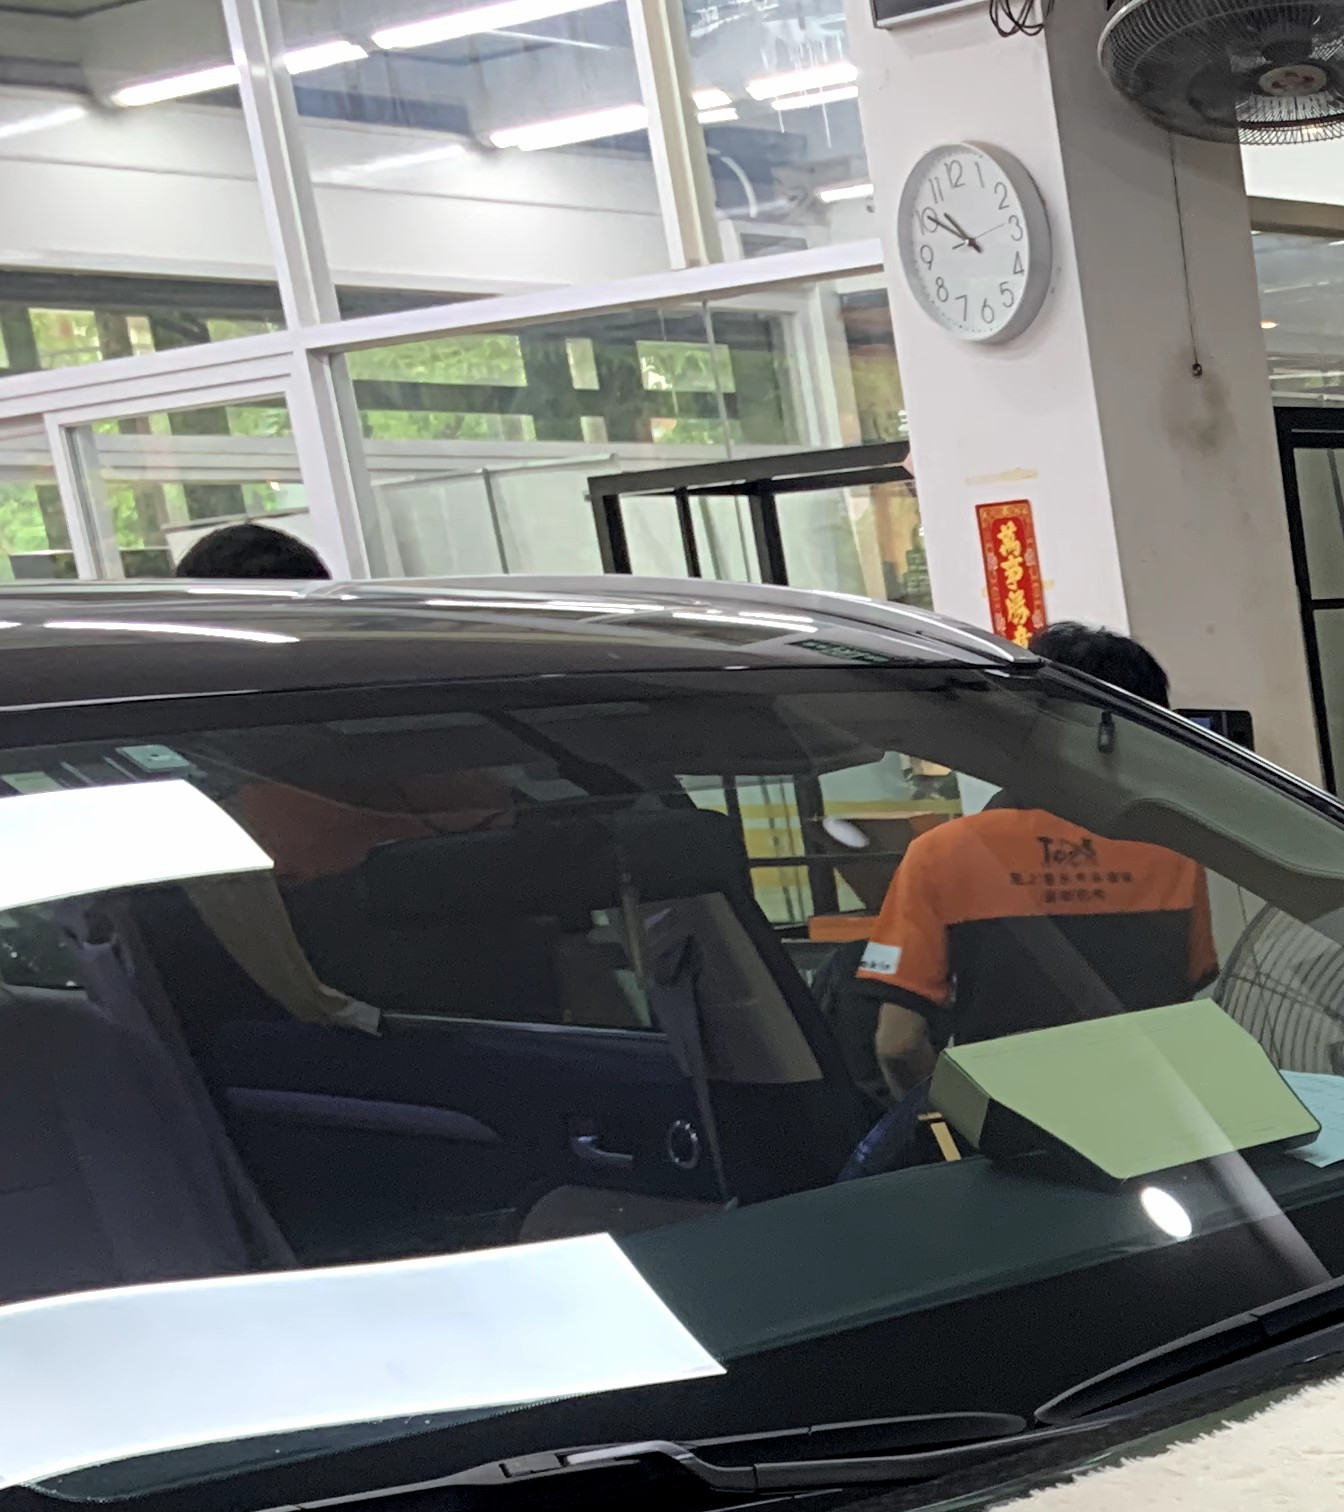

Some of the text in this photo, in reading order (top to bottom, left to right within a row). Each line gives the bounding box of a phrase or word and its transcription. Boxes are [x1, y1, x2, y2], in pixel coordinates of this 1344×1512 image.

[944, 159, 966, 188] 12
[975, 162, 985, 188] 1
[929, 176, 944, 204] 11
[994, 182, 1010, 211] 2
[915, 207, 938, 235] 10
[1008, 214, 1023, 242] 3
[920, 244, 933, 271] 9
[1013, 251, 1025, 276] 4
[935, 276, 949, 303] 8
[999, 281, 1014, 308] 5
[955, 294, 968, 322] 7
[981, 298, 995, 324] 6
